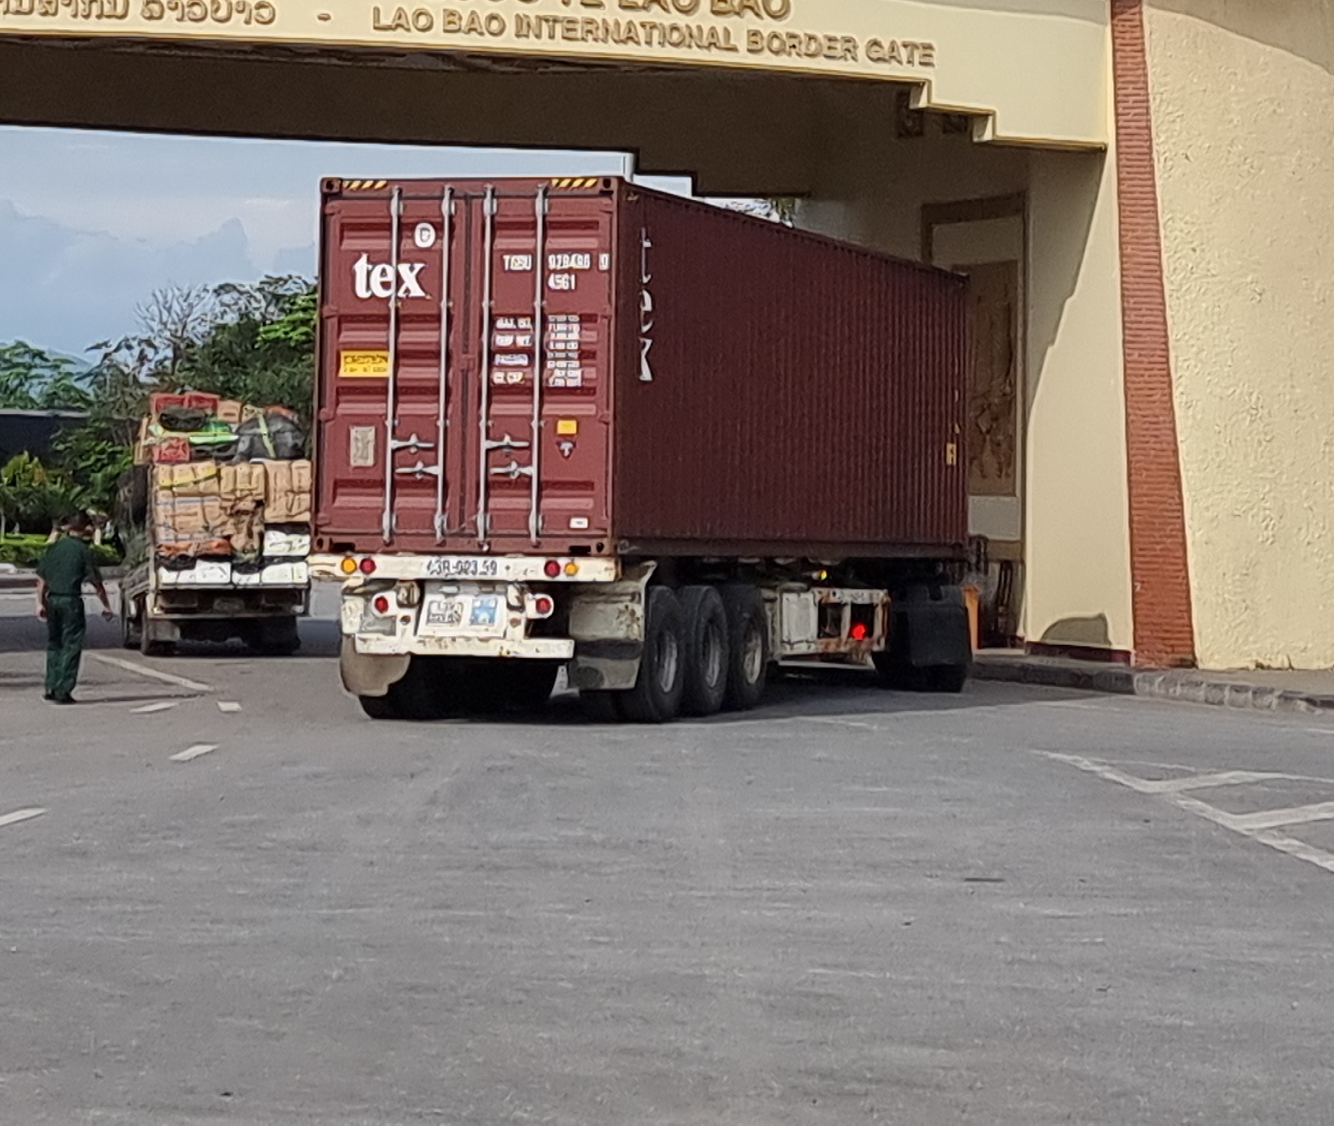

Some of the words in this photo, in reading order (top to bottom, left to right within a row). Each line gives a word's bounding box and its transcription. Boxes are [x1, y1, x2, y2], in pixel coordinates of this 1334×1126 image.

[371, 7, 434, 33] LAO
[443, 9, 506, 37] BAO
[515, 13, 738, 52] INTERNATIONAL
[746, 31, 859, 62] BORDER
[866, 38, 936, 68] GATE
[352, 251, 429, 298] tex
